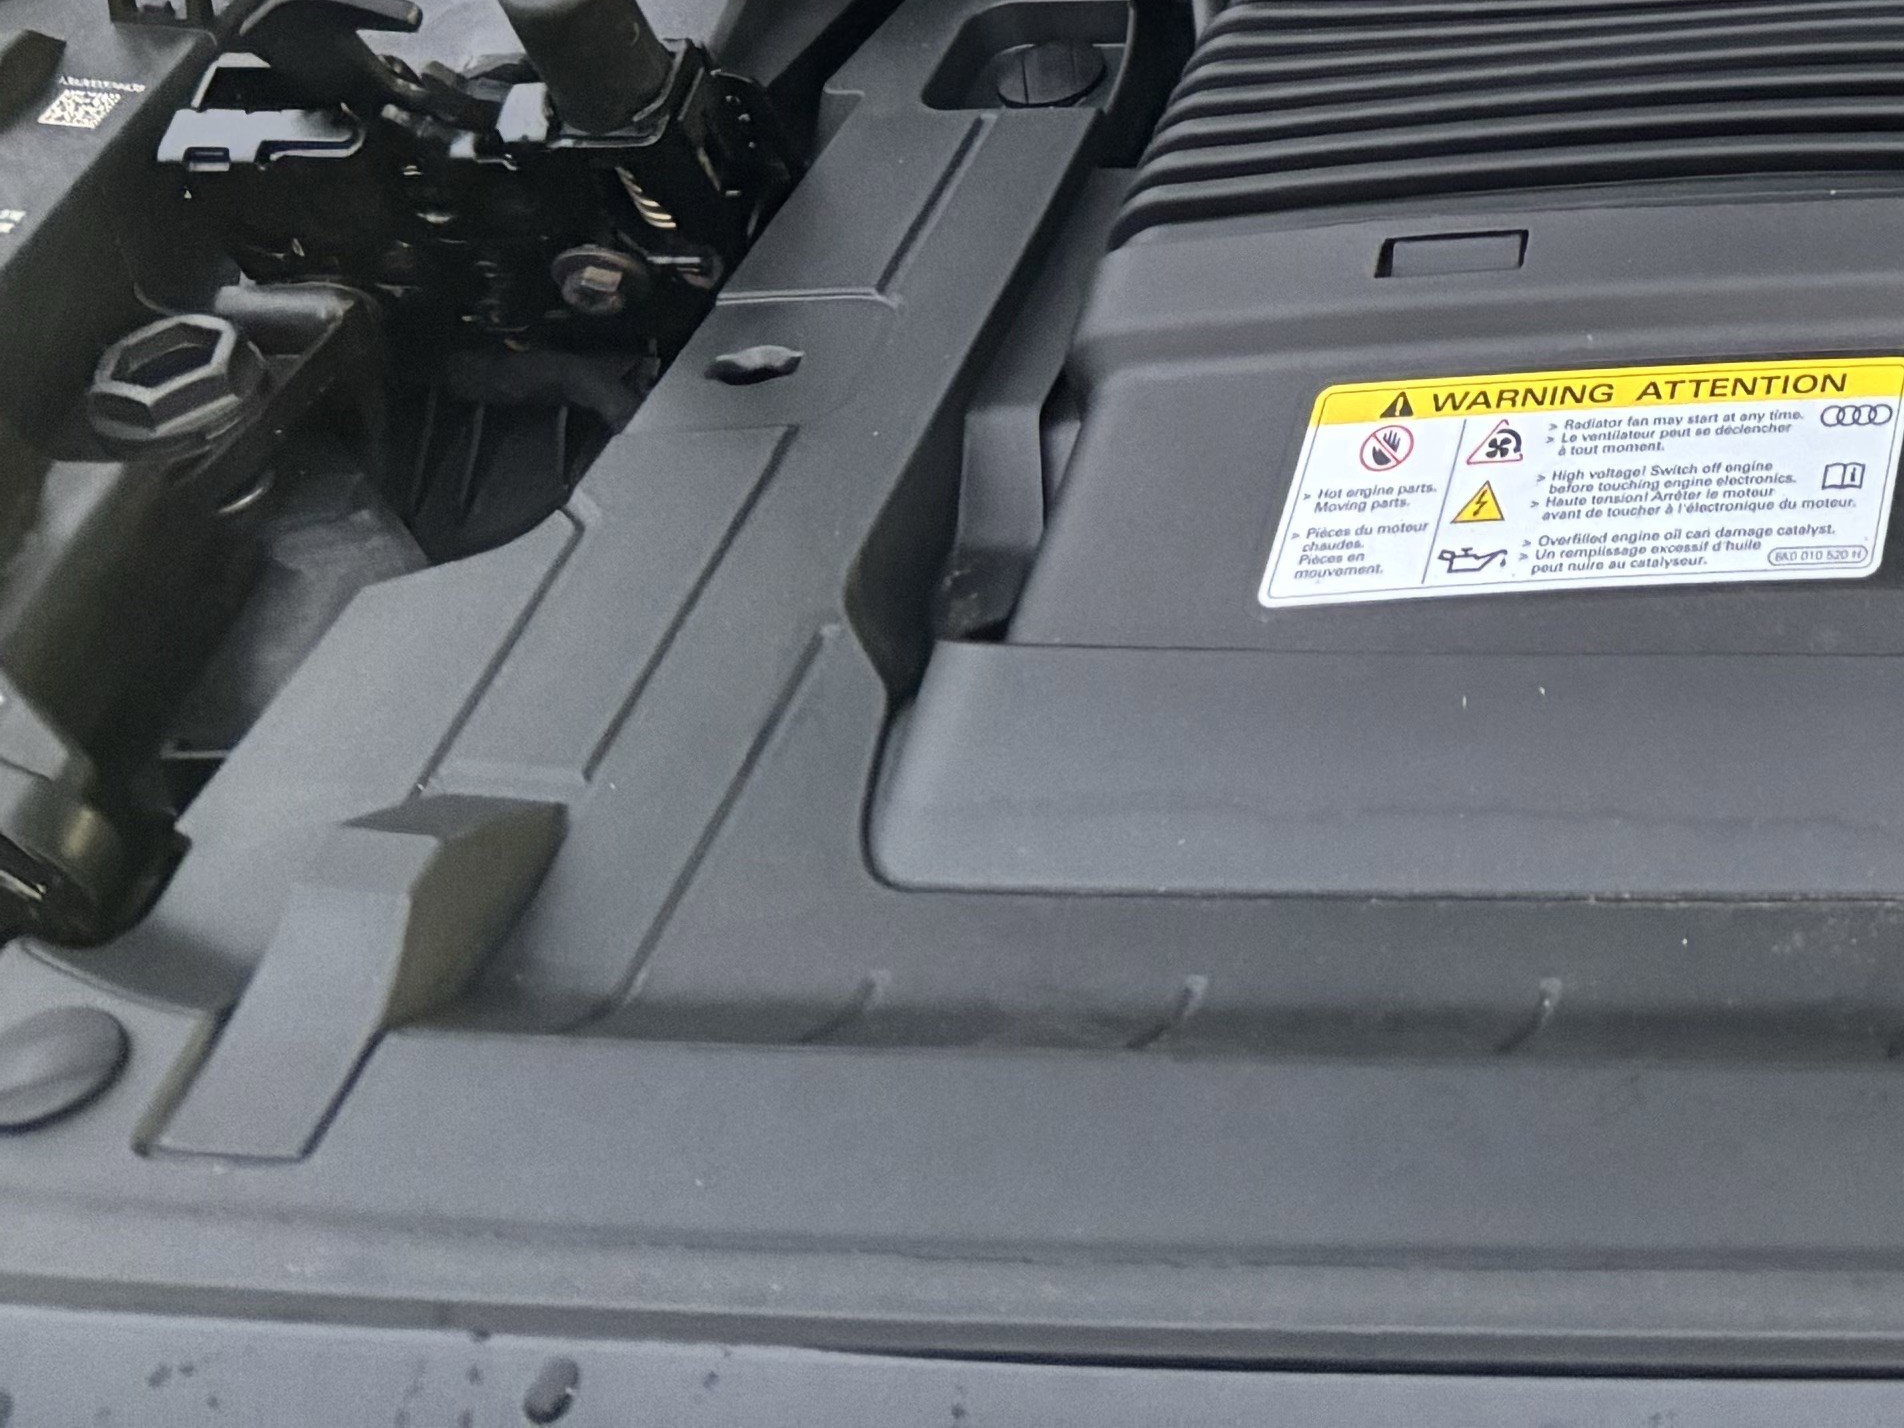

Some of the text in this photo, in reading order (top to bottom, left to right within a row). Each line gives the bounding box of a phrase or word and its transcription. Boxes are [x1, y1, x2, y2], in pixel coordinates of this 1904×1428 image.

[1432, 373, 1847, 412] WARNING ATTENTION
[1563, 409, 1804, 431] Radiator fan may start at any time.
[1561, 422, 1792, 443] Le ventilateur peut se déclencher
[1558, 442, 1665, 455] à tout moment.
[1551, 461, 1773, 483] High voltage! Switch off engine
[1318, 482, 1437, 499] Hot engine parts.
[1549, 473, 1796, 494] before touching engine electronics.
[1314, 498, 1410, 514] Moving parts.
[1545, 495, 1587, 508] Haute
[1651, 489, 1702, 503] Arrêter
[1706, 488, 1718, 499] le
[1722, 487, 1773, 498] moteur
[1542, 497, 1856, 521] avant de toucher à l'électronique du moteur.
[1306, 522, 1429, 540] Pièces du moteur
[1538, 523, 1836, 547] Overfilled engine oil can damage catalyst.
[1302, 540, 1364, 553] chaudes.
[1535, 549, 1555, 561] Un
[1559, 544, 1647, 561] remplissage
[1651, 542, 1709, 555] excessif
[1298, 553, 1365, 566] Pièces en
[1531, 556, 1707, 576] peut nuire au catalyseur.
[1294, 564, 1384, 579] mouvement.
